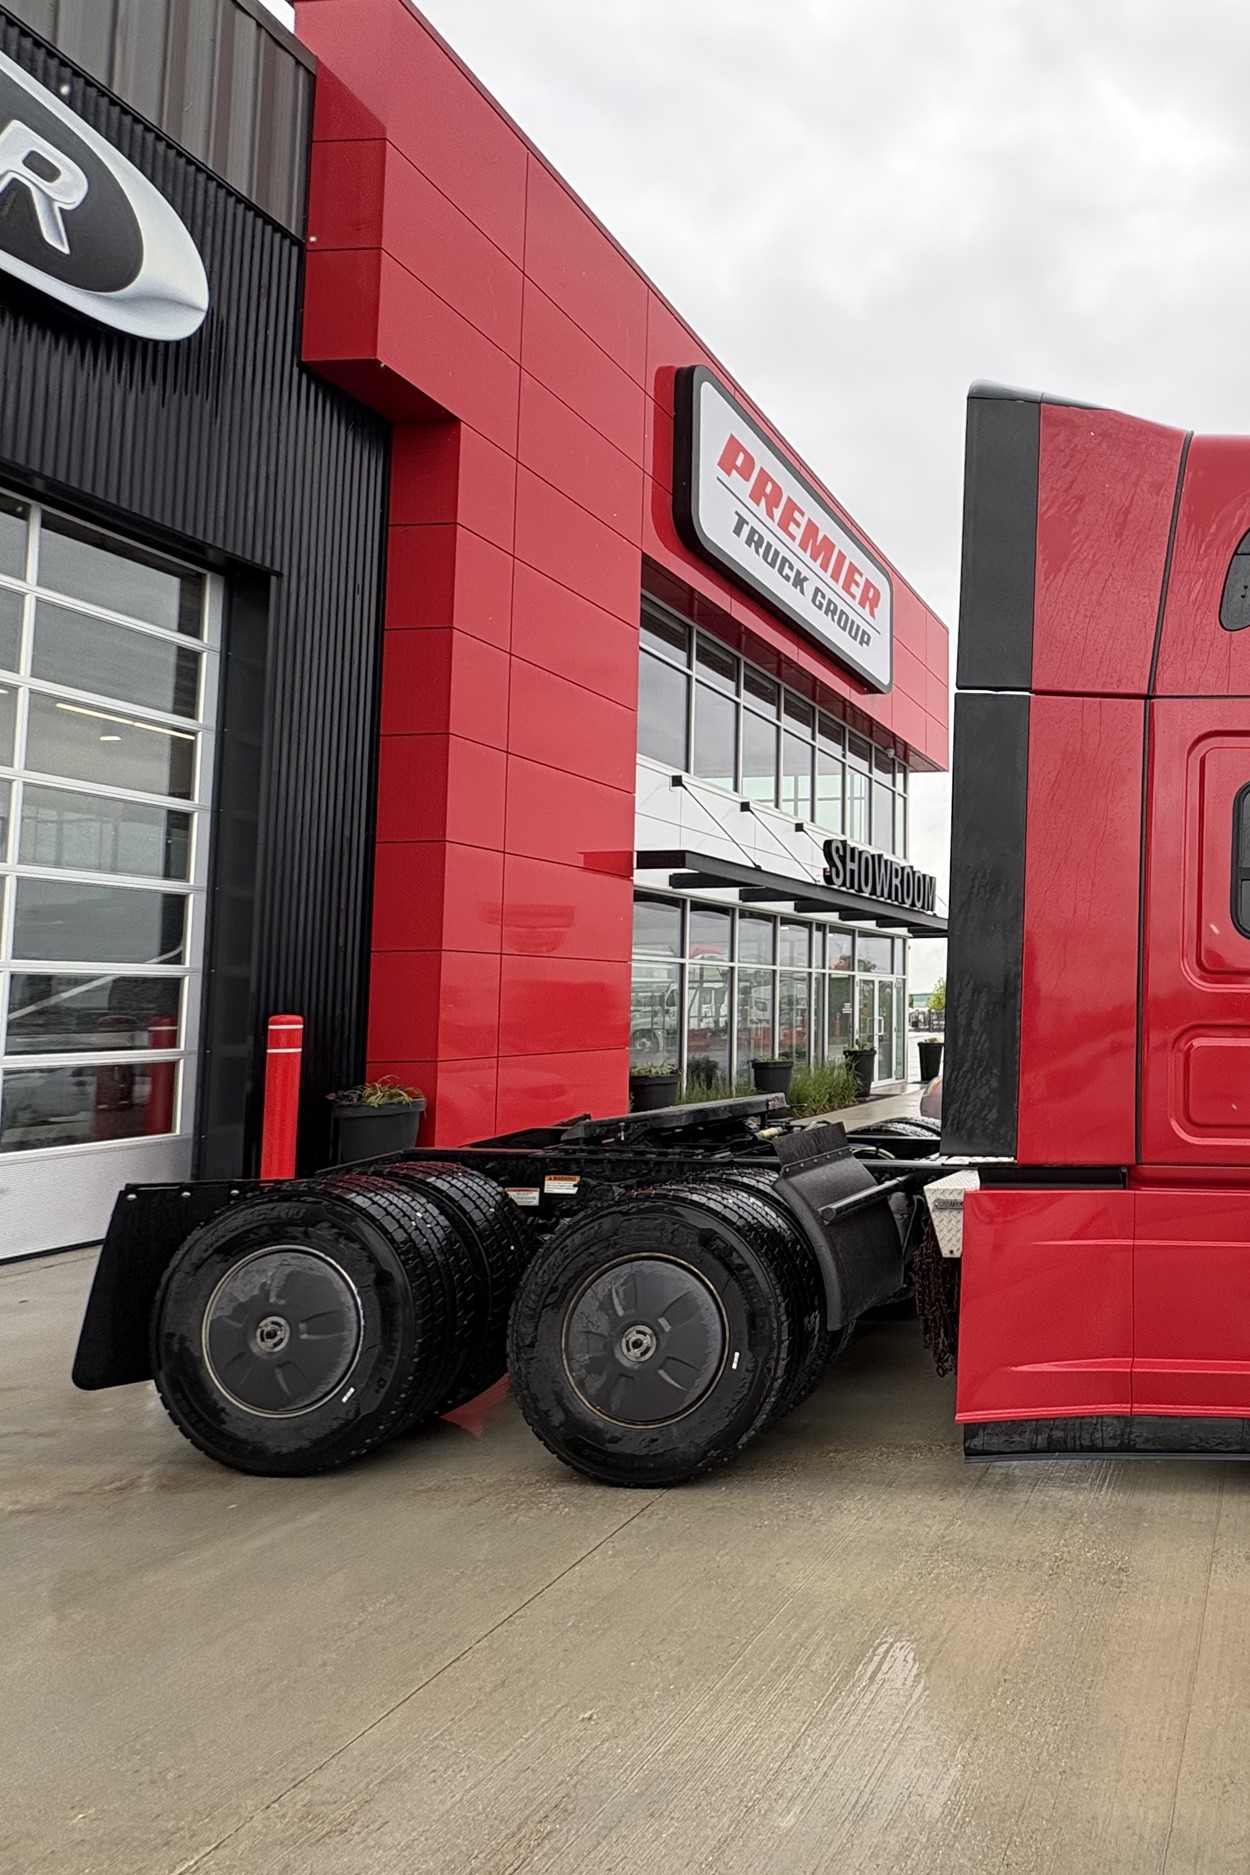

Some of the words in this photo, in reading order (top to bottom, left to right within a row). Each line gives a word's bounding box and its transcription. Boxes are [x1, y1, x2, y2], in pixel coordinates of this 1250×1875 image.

[717, 433, 881, 620] PREMIER
[732, 509, 810, 597] TRUCK
[811, 585, 872, 648] GROUP
[825, 839, 936, 912] SHOWROOM
